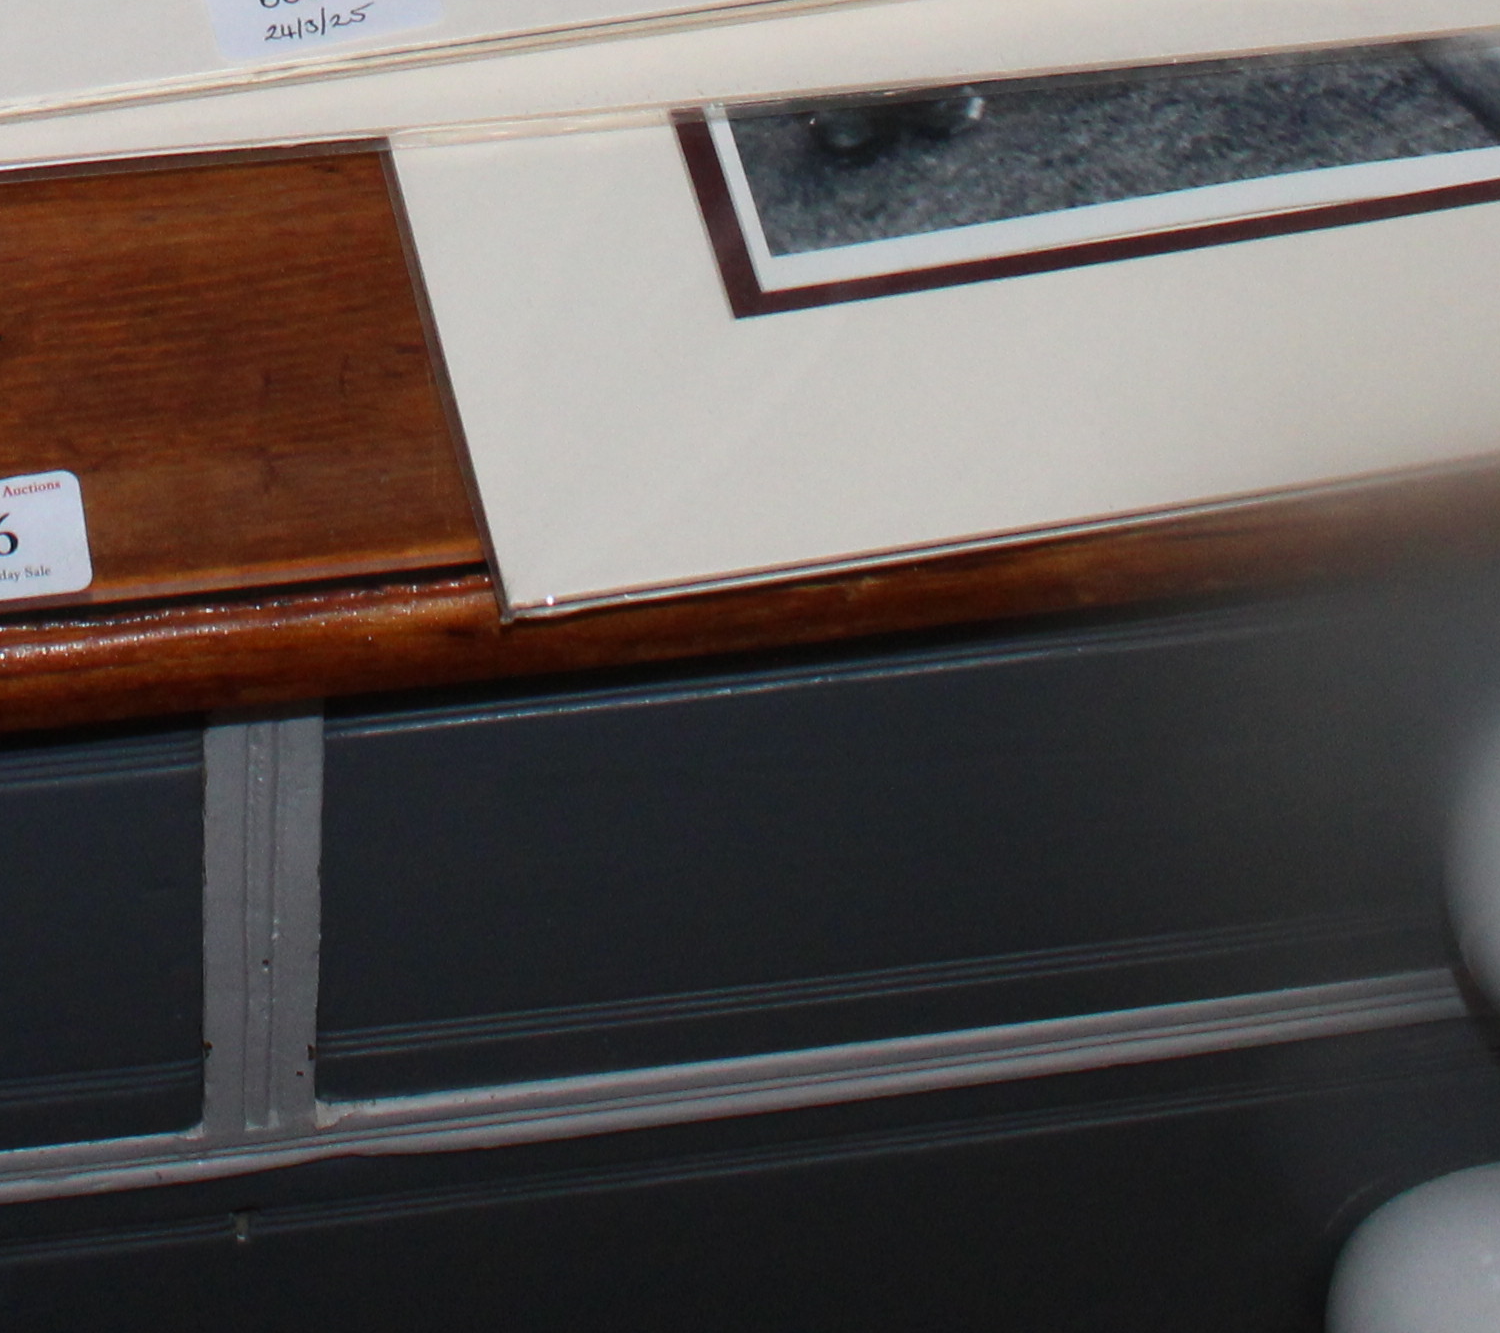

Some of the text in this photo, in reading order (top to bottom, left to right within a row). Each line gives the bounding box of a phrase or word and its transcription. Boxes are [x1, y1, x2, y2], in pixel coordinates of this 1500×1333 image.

[263, 1, 375, 41] 24/3/25
[2, 480, 61, 498] Auctions
[25, 564, 51, 578] Sale
